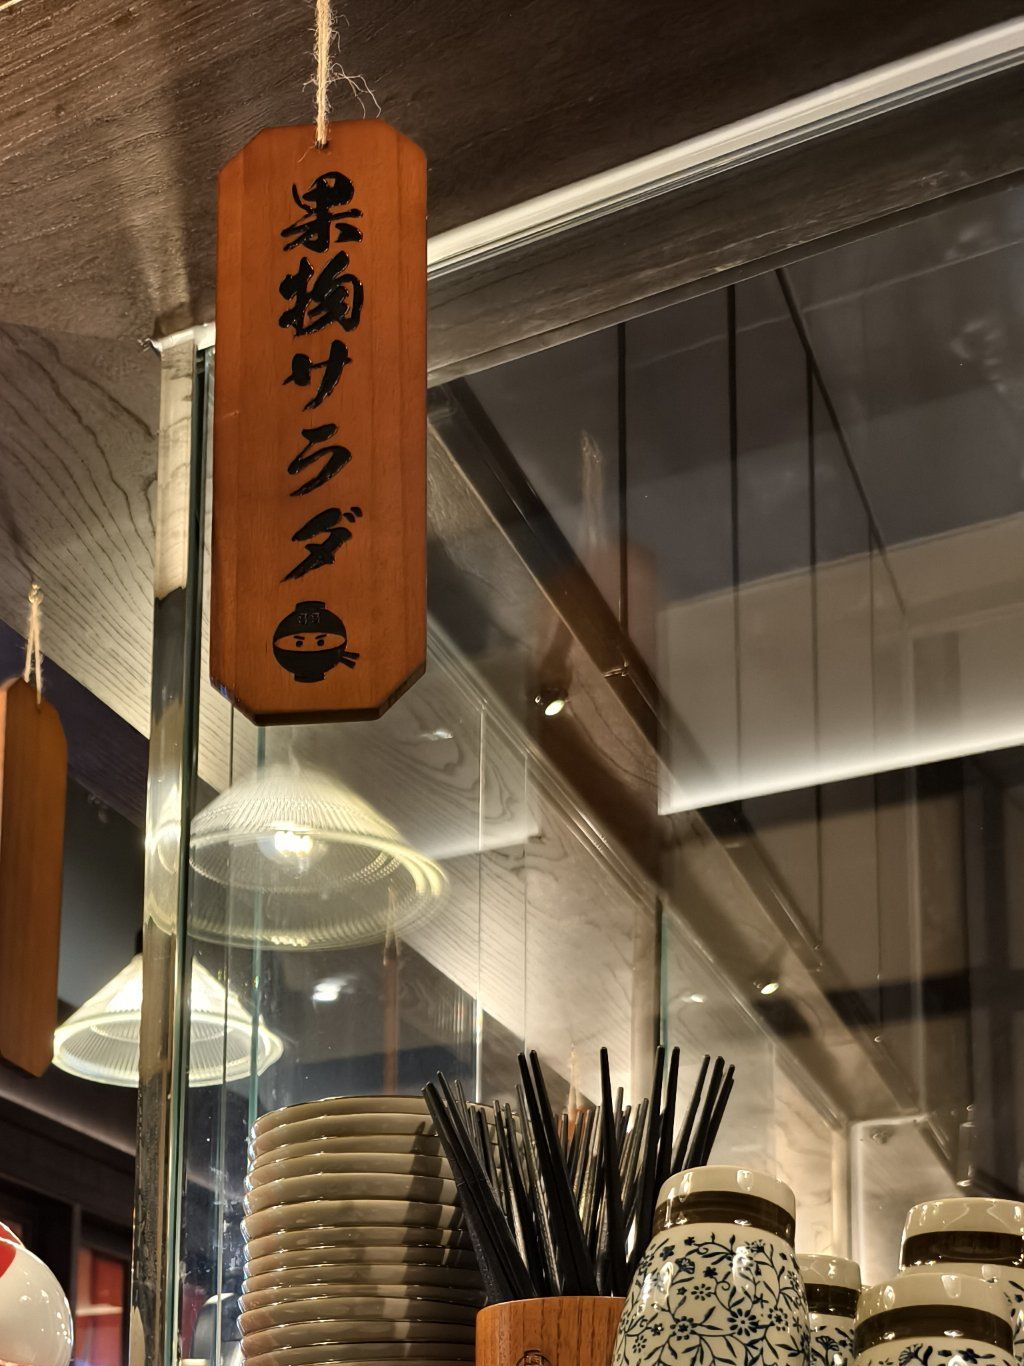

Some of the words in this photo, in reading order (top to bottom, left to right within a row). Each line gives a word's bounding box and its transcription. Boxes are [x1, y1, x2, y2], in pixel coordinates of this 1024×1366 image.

[279, 171, 364, 583] 果物サラダ
